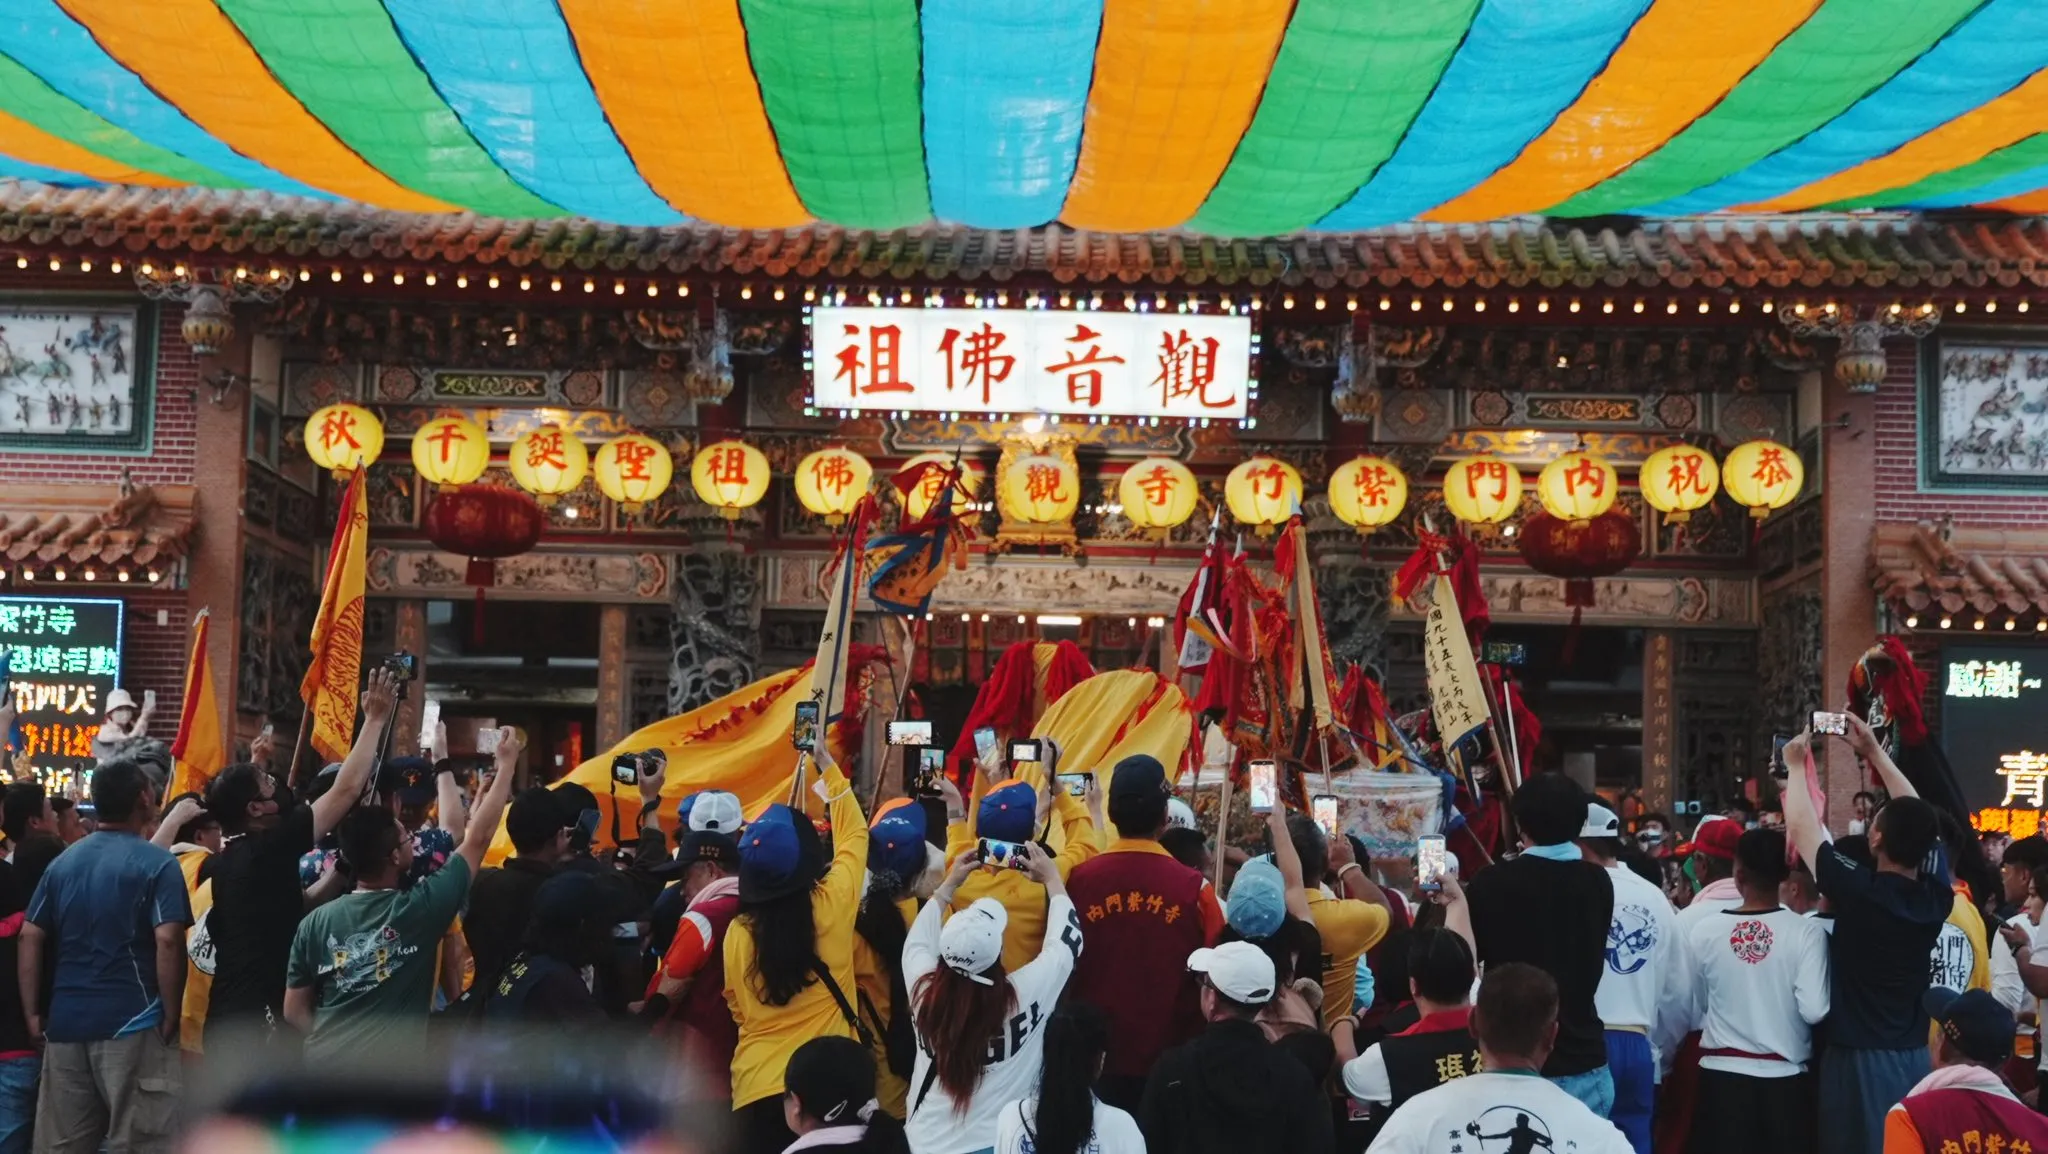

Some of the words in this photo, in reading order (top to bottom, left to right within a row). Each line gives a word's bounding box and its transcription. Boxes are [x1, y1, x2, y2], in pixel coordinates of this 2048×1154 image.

[318, 409, 362, 450] 秋
[426, 423, 468, 463] 千
[526, 431, 569, 471] 誕
[613, 440, 655, 482] 聖
[705, 448, 750, 486] 祖
[1751, 447, 1793, 488] 恭
[810, 454, 855, 496] 佛
[1024, 463, 1068, 505] 觀
[1137, 465, 1180, 506] 寺
[1245, 462, 1287, 500] 竹
[1353, 465, 1396, 507] 紫
[1464, 460, 1507, 501] 門
[1565, 458, 1605, 498] 內
[1667, 454, 1710, 496] 祝
[1086, 890, 1181, 924] 內門紫竹寺
